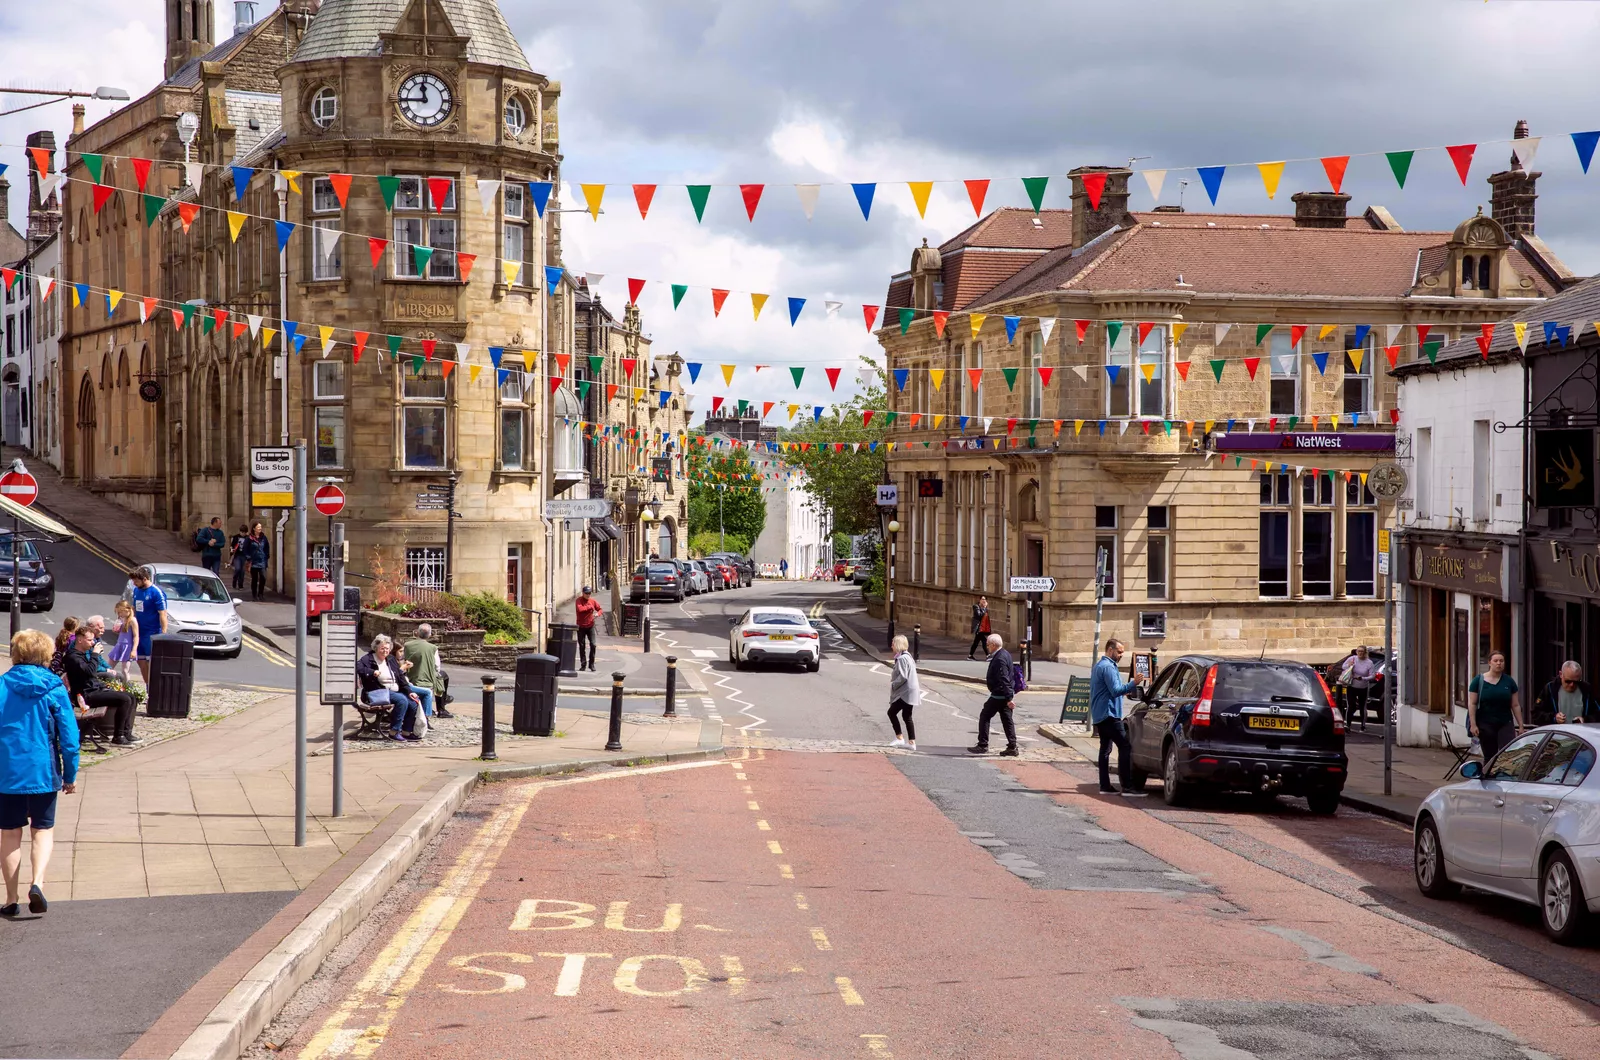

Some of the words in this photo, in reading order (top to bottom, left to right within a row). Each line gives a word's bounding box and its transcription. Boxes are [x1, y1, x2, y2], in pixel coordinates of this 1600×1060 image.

[398, 303, 455, 317] LIBRARY
[1296, 436, 1341, 448] NatWest
[1252, 718, 1276, 727] PN58
[1279, 720, 1296, 728] YNJ
[508, 899, 734, 932] BU
